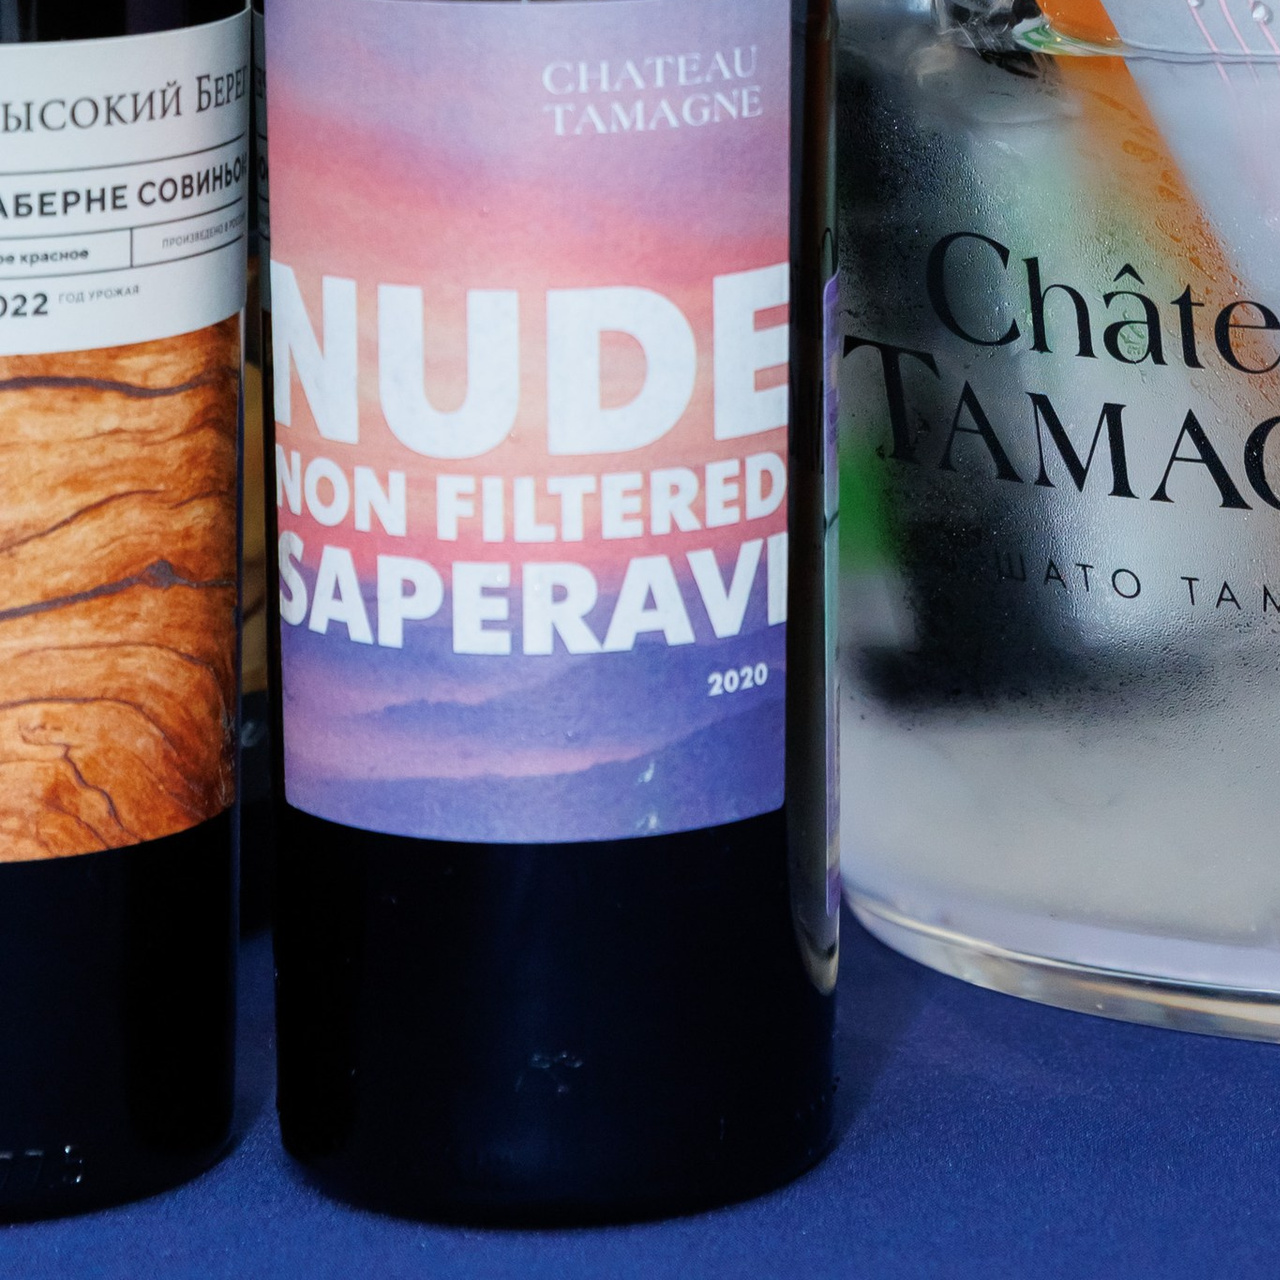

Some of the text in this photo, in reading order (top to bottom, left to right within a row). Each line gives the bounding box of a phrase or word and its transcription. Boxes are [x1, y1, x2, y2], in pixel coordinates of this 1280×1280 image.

[542, 46, 758, 95] CHATEAU
[0, 80, 183, 134] ЫСОКИЙ
[544, 86, 763, 136] TAMAGNE
[20, 246, 90, 267] красное
[58, 284, 140, 305] ГОД УРОЖАЯ
[270, 259, 790, 459] NUDE
[275, 443, 787, 542] NON FILTERED
[278, 531, 789, 657] SAPERAVI
[706, 662, 770, 697] 2020
